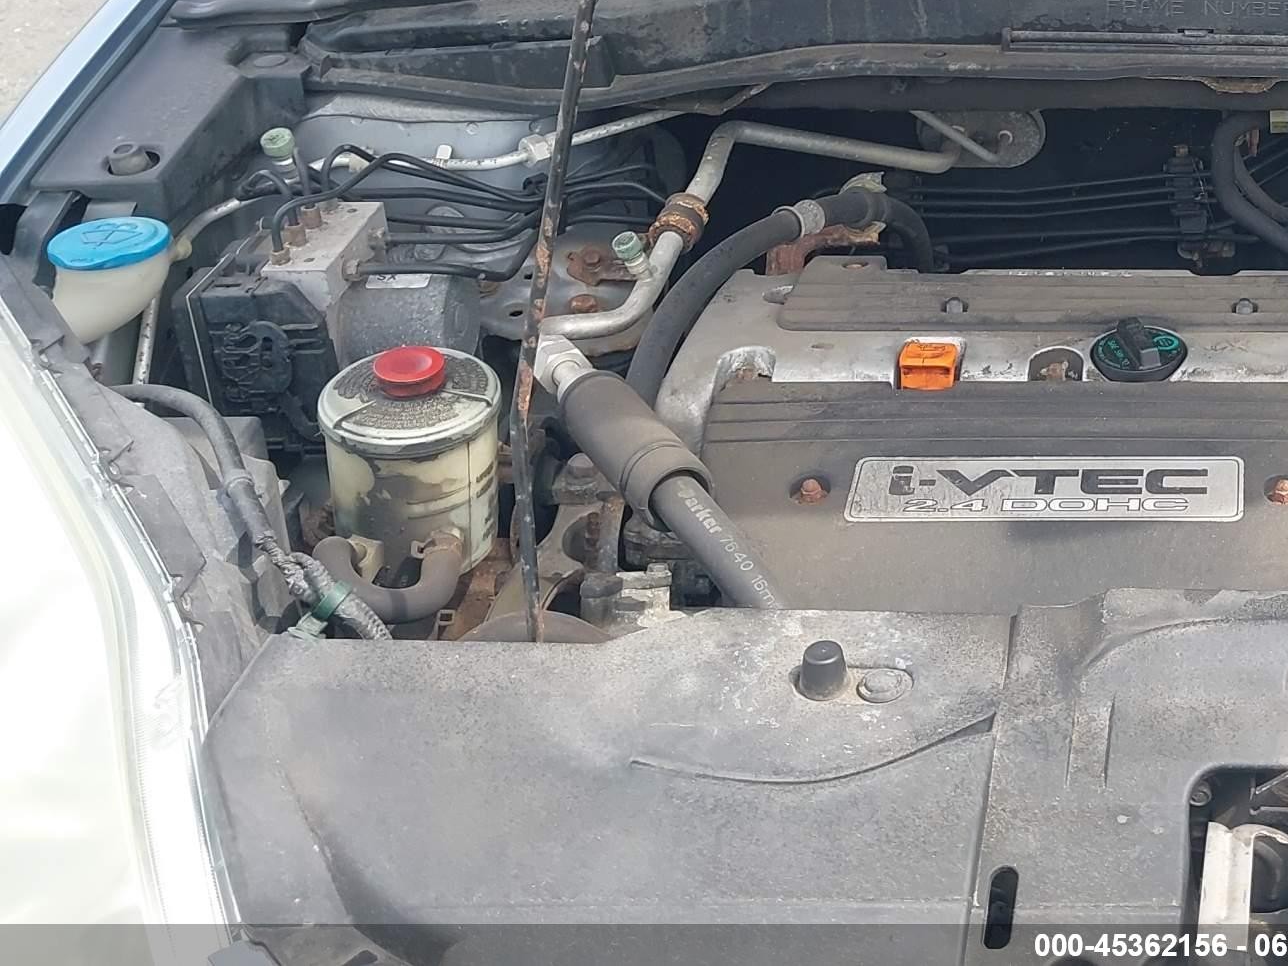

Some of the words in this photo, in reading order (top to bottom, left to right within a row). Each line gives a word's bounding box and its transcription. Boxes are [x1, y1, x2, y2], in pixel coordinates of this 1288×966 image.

[889, 465, 1209, 496] i-VTEC
[903, 498, 989, 513] 2.4
[1001, 497, 1191, 512] DOHC
[751, 574, 778, 609] 16m
